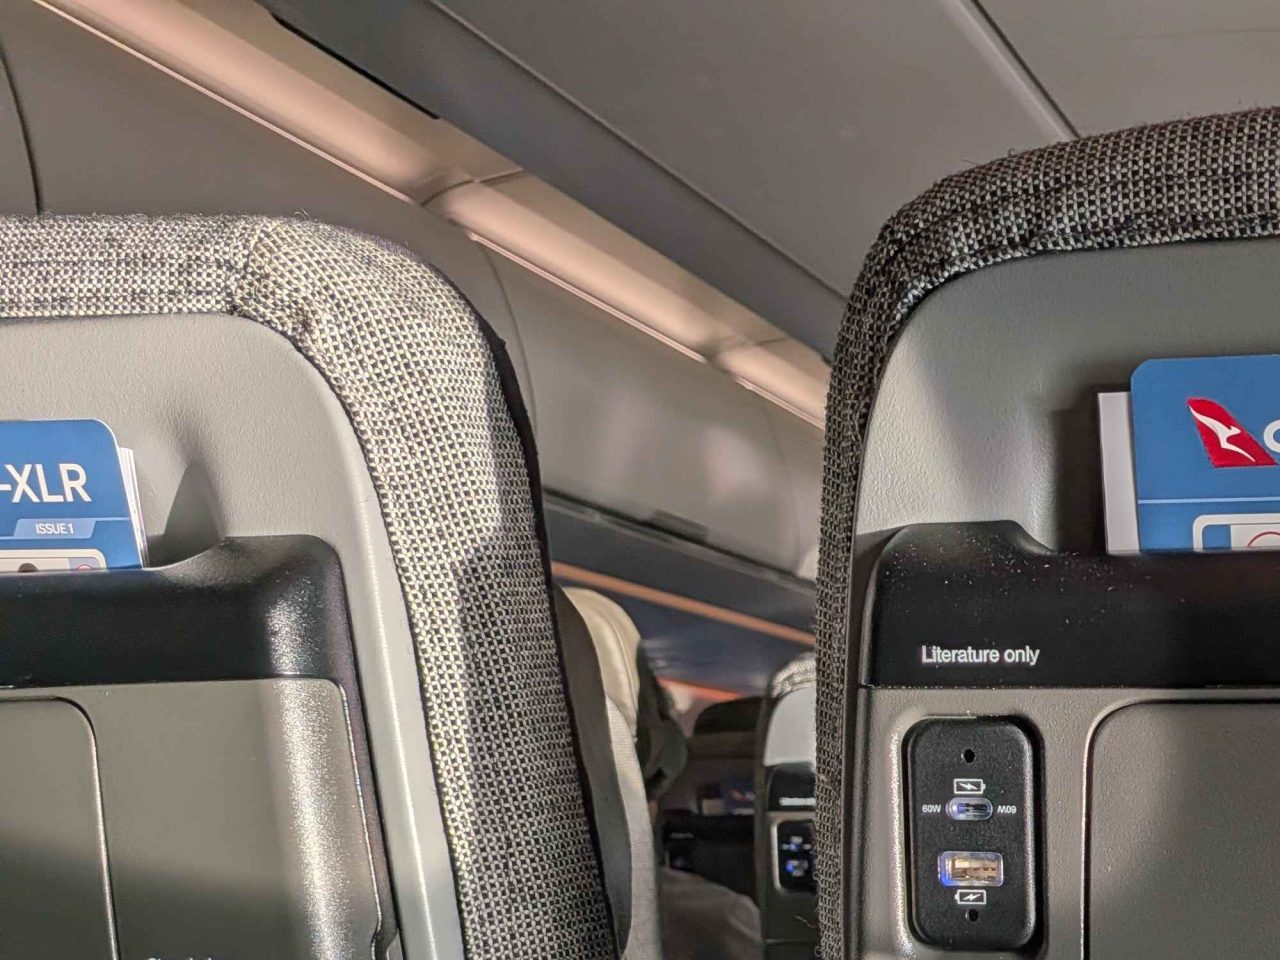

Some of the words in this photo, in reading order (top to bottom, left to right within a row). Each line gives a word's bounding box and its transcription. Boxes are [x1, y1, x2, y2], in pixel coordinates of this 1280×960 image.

[35, 523, 68, 534] ISSUE
[921, 645, 1000, 663] Literature
[1004, 645, 1040, 666] only
[922, 804, 941, 813] 60W
